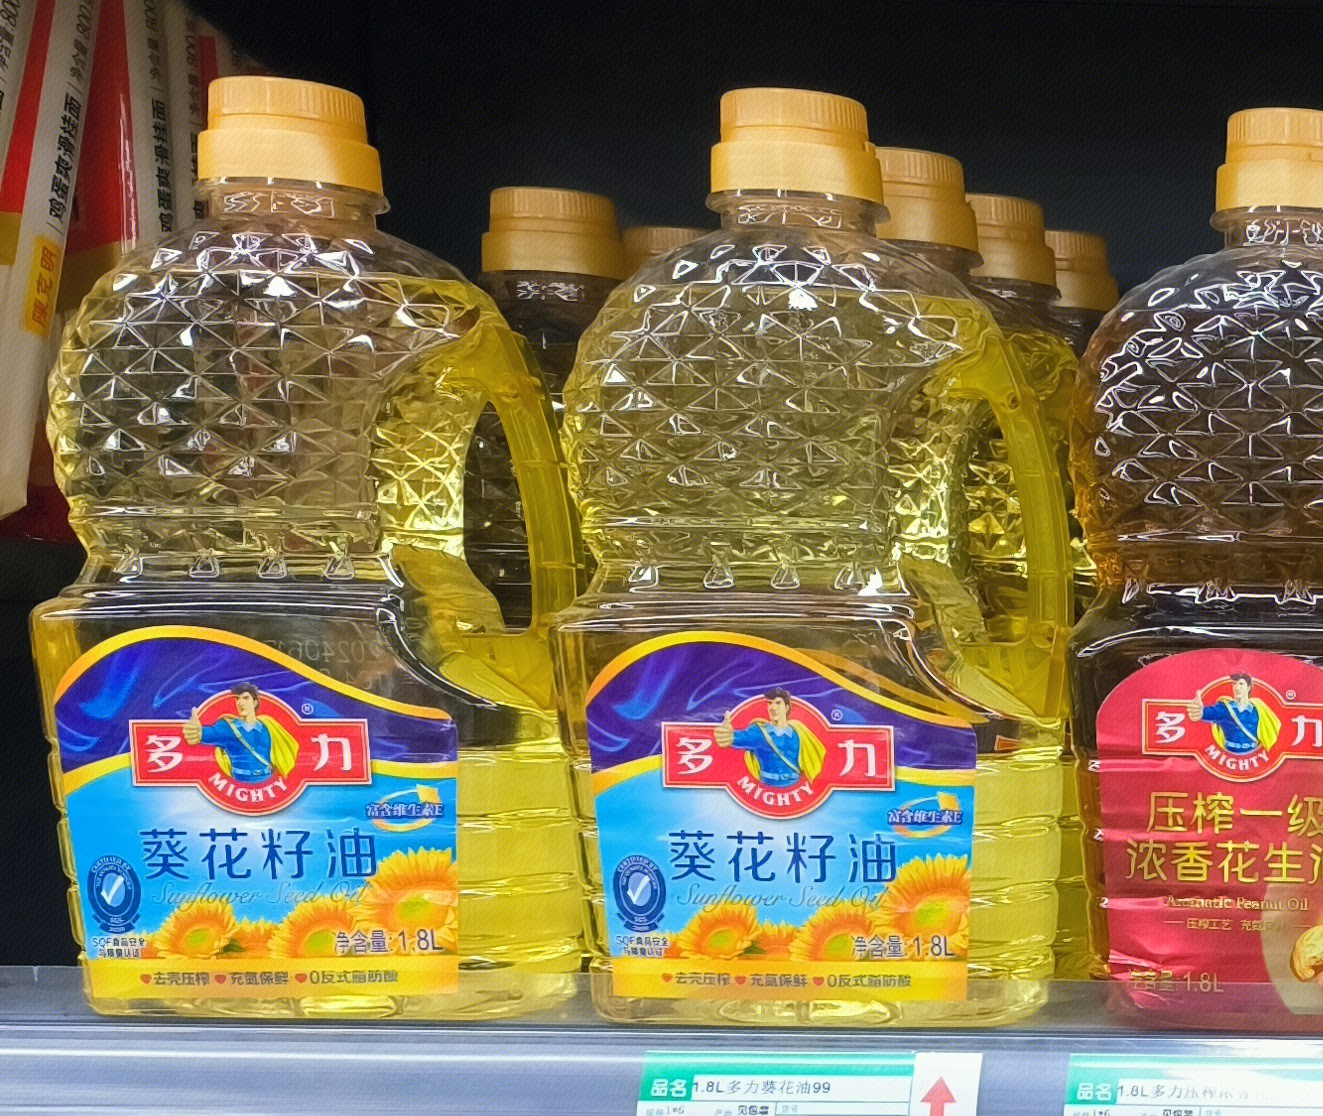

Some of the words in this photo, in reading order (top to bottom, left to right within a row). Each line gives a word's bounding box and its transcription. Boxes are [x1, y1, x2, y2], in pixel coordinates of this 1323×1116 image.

[48, 92, 83, 222] 鸡蛋爽滑挂面
[31, 244, 56, 329] 陳克明
[1205, 745, 1271, 772] MIGHTY
[208, 770, 289, 804] MIGHTY
[736, 775, 815, 808] MIGHTY
[139, 828, 376, 880] 葵花籽油
[669, 830, 897, 883] 葵花籽油
[151, 880, 261, 913] Sunflower
[267, 880, 324, 906] Seed
[677, 883, 786, 913] Sunflower
[788, 884, 843, 907] Seed
[1287, 898, 1309, 911] Oil
[334, 929, 444, 955] 净含量:1.8L
[850, 934, 956, 958] 净含量:1.8L
[153, 971, 210, 987] 去壳压榨
[230, 971, 290, 986] 充氮保鲜
[674, 972, 731, 987] 去壳压榨
[651, 1078, 688, 1098] 品名
[1077, 1083, 1112, 1101] 品名
